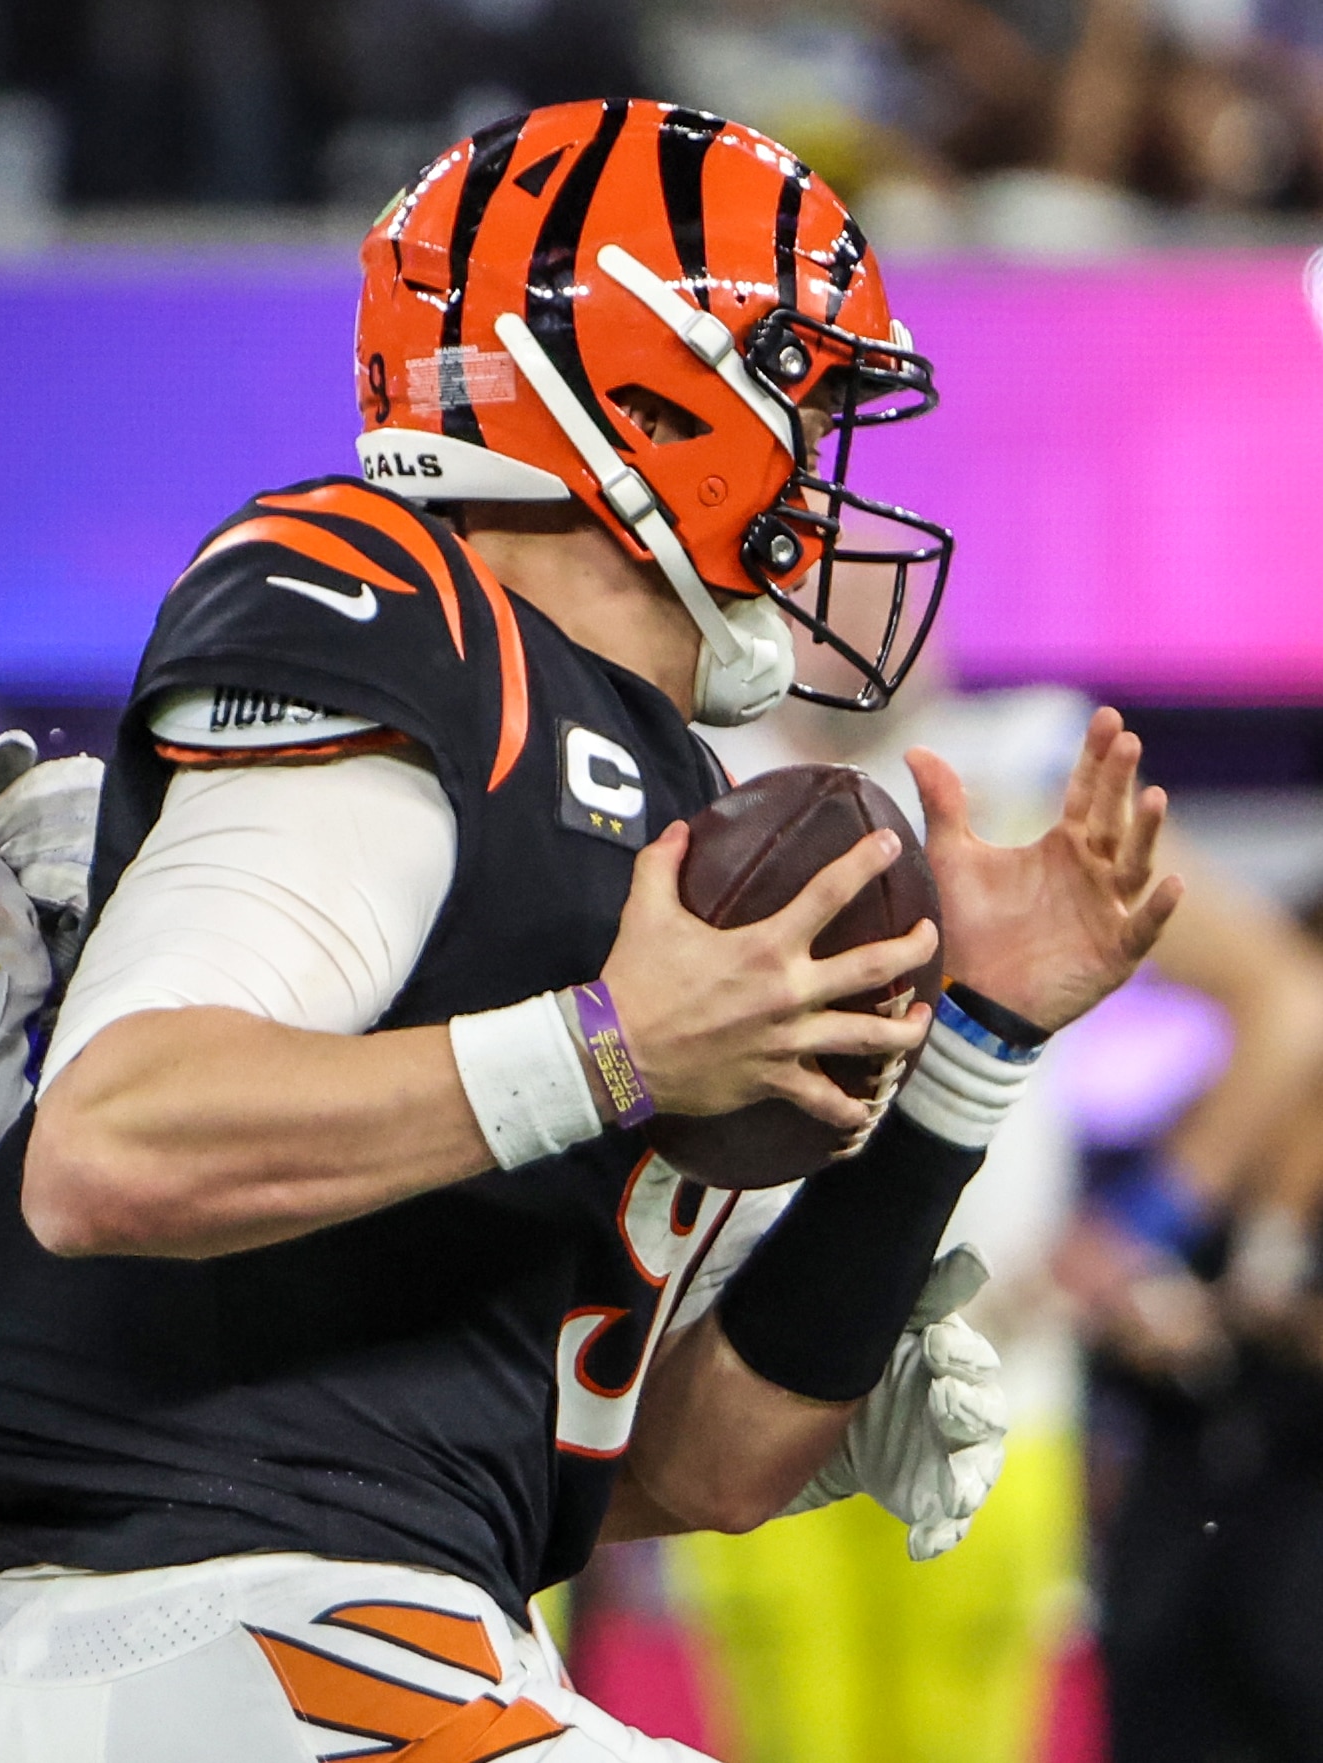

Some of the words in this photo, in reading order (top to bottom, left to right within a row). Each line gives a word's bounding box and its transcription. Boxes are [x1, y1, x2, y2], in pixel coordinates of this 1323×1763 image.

[368, 353, 391, 424] 9
[566, 726, 644, 818] C
[589, 1030, 633, 1112] TIGERS
[555, 1147, 741, 1460] 9
